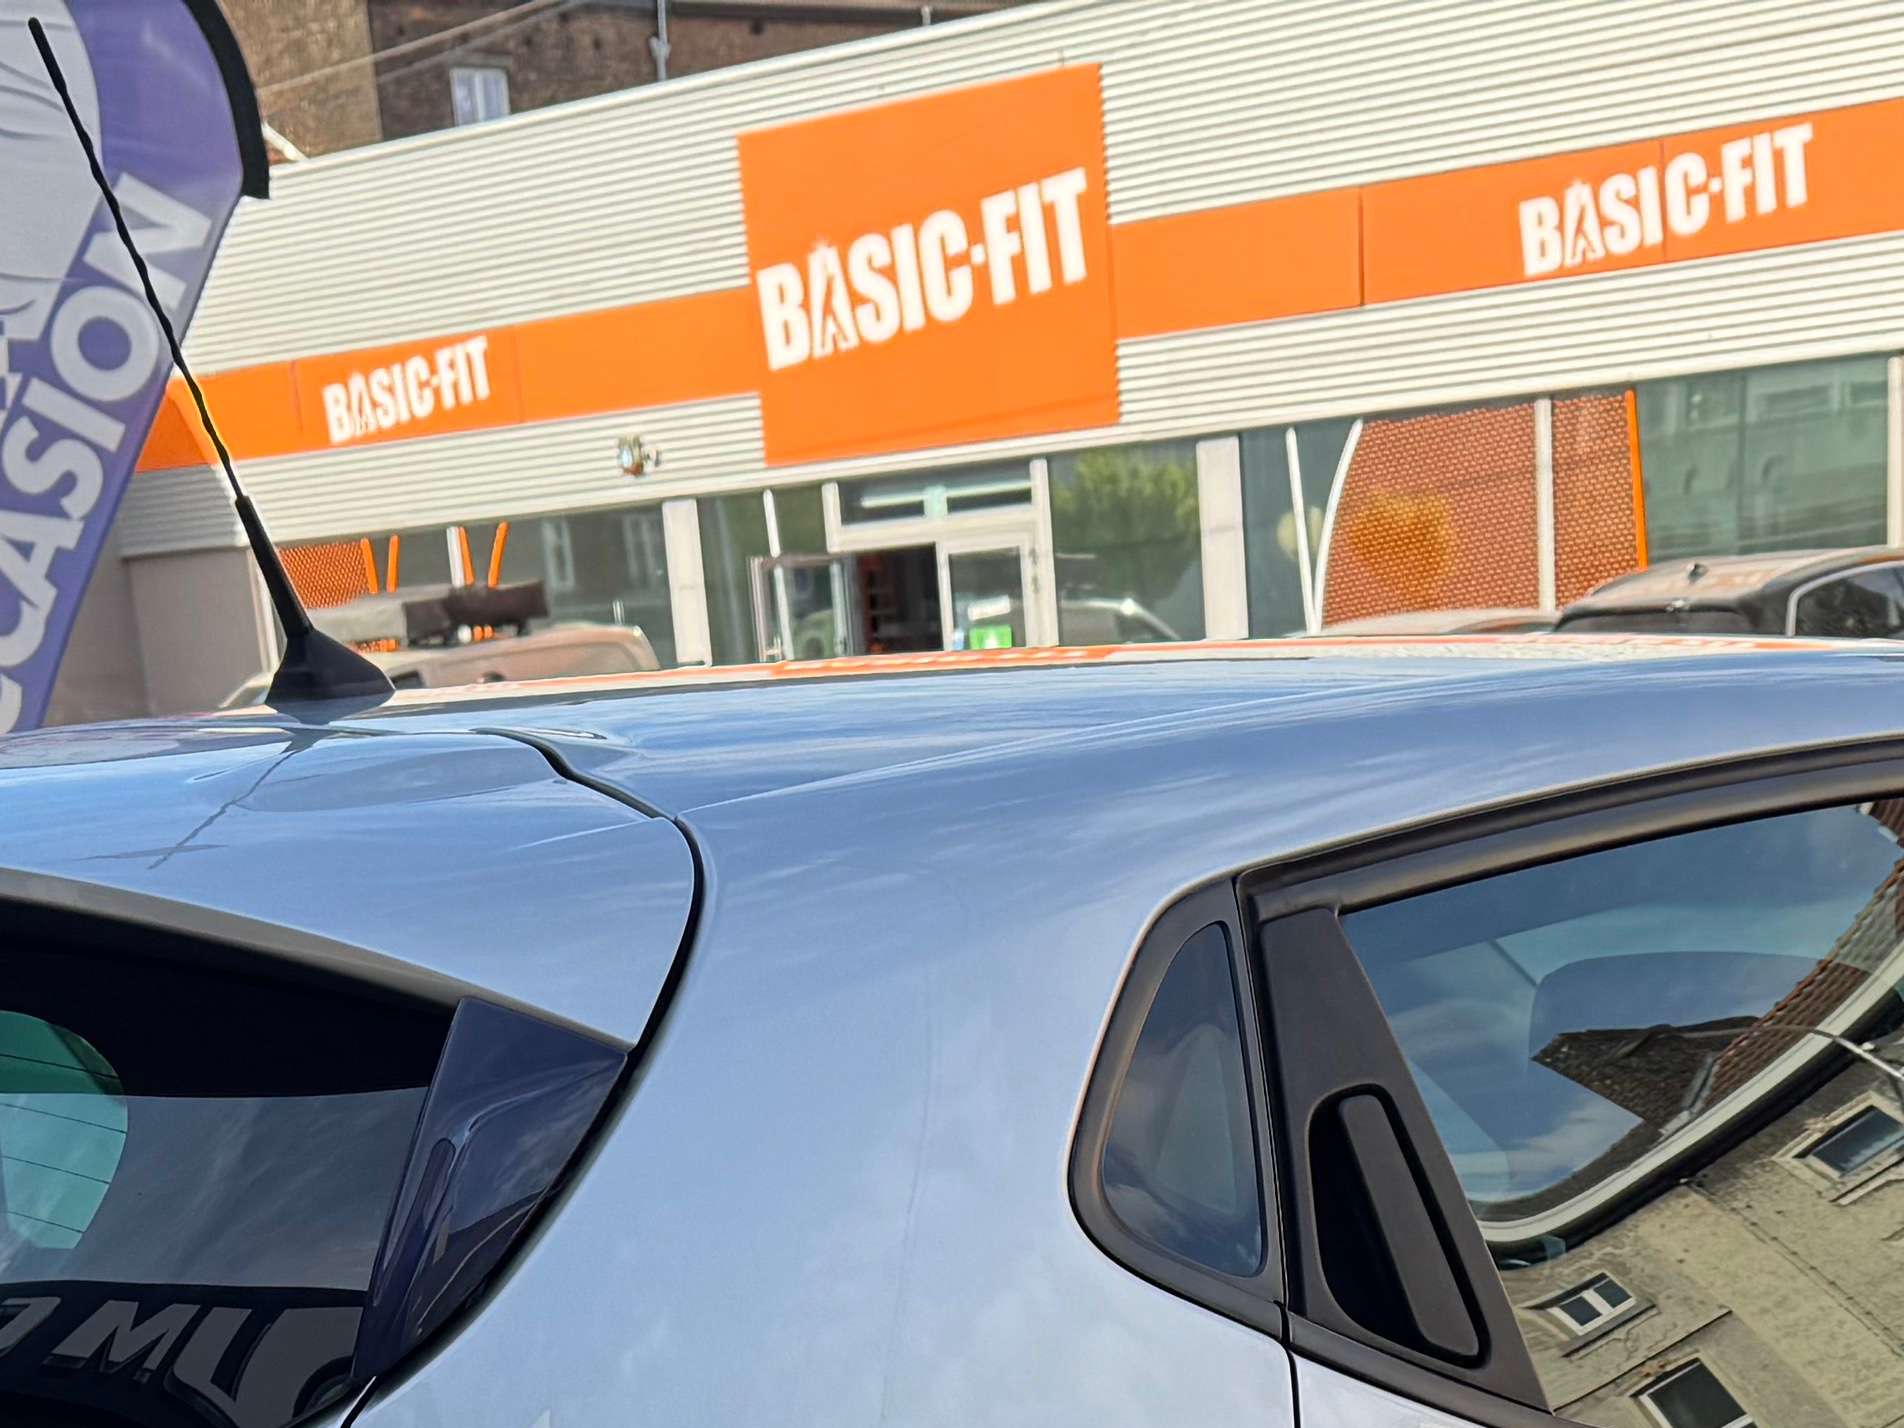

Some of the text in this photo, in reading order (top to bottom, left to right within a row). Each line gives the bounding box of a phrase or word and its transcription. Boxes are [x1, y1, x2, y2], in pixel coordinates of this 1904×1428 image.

[755, 166, 1088, 372] BASIC-FIT
[1518, 121, 1813, 277] BASIC-FIT
[322, 334, 491, 445] BASIC-FIT
